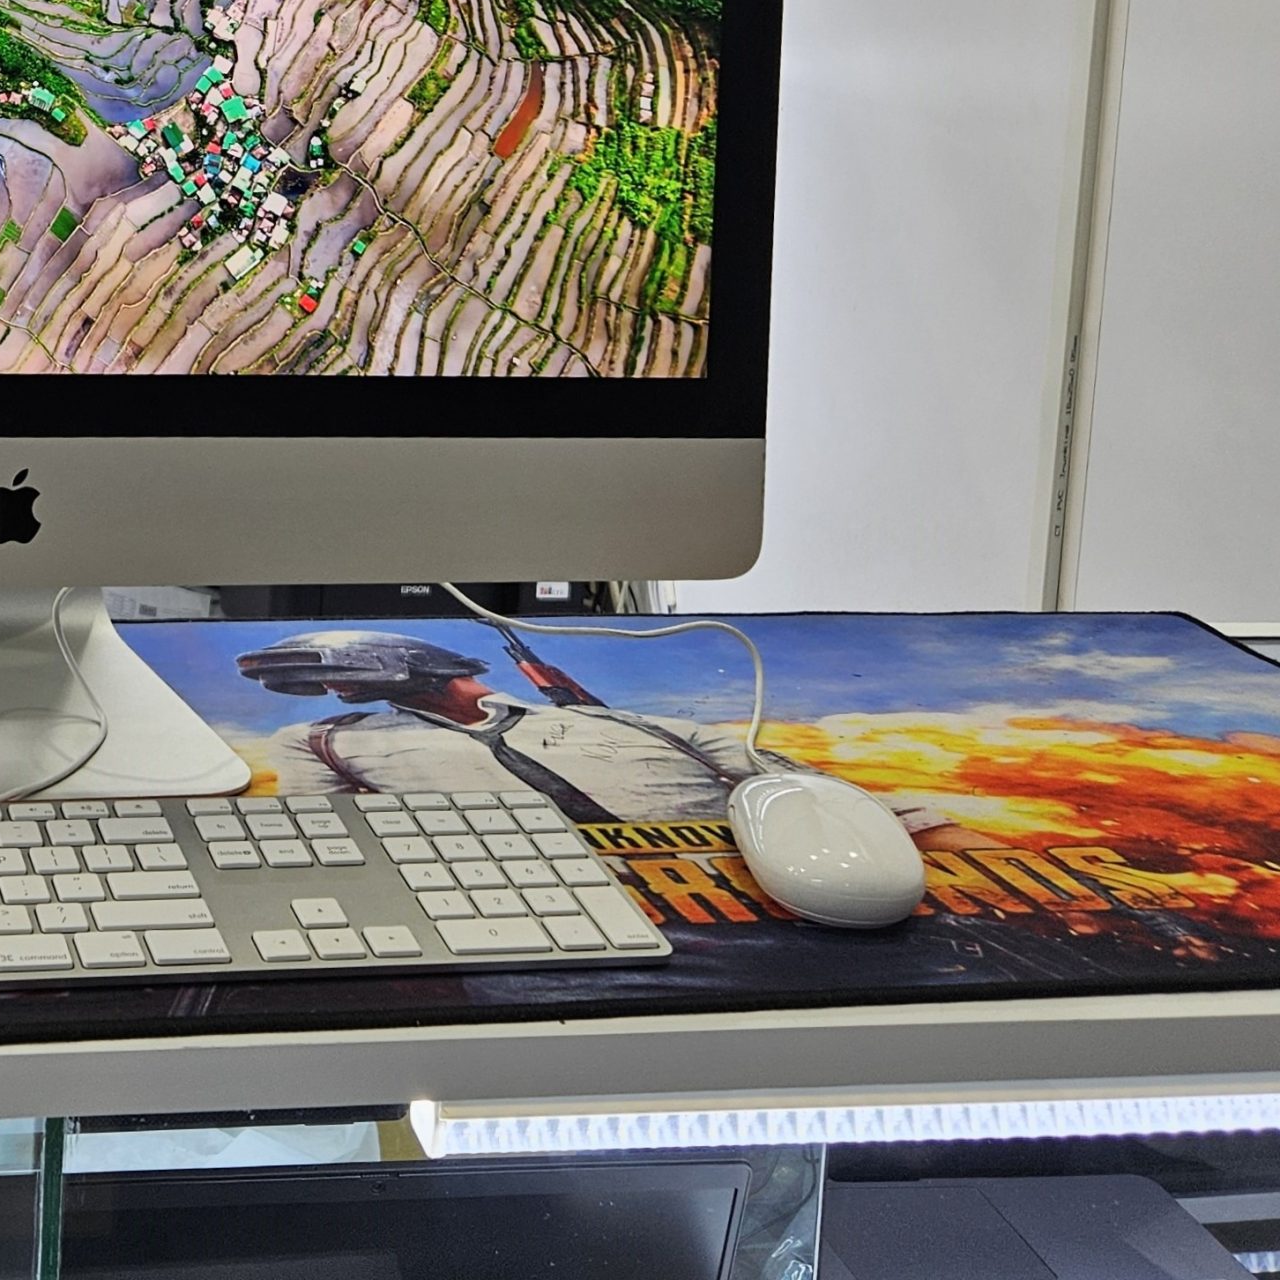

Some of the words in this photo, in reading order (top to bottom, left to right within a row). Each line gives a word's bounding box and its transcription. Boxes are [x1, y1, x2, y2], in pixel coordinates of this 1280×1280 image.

[400, 585, 430, 595] EPSON
[493, 897, 504, 906] 2
[546, 894, 556, 903] 3
[488, 927, 499, 937] 0
[19, 953, 68, 962] command
